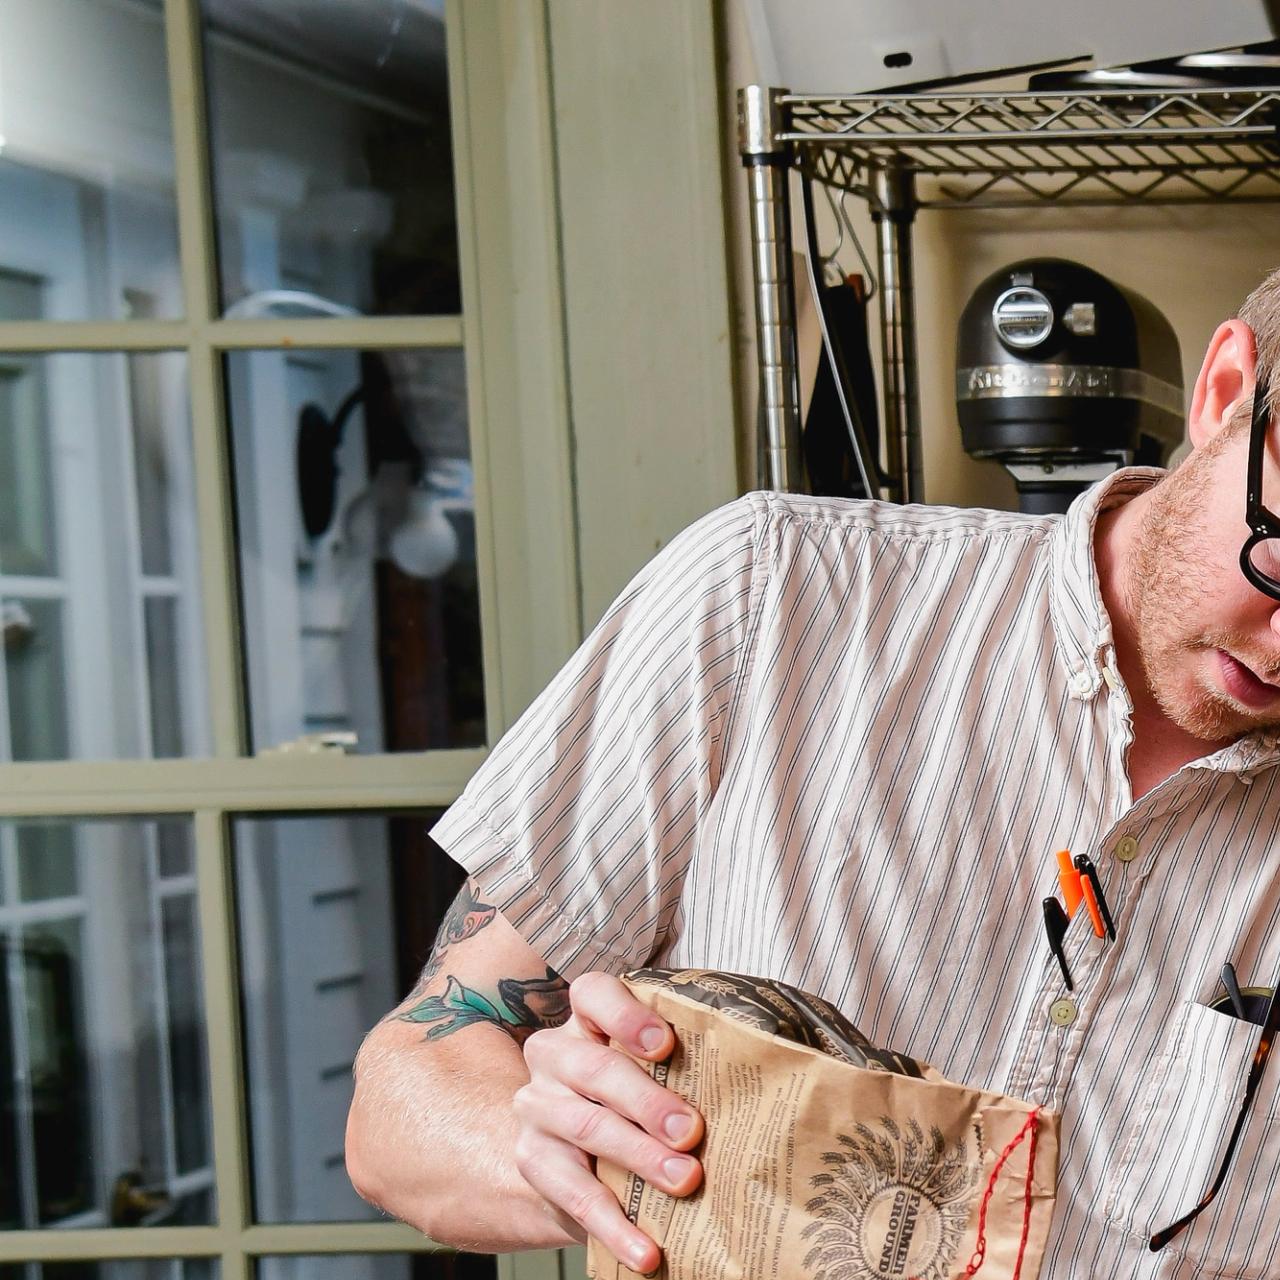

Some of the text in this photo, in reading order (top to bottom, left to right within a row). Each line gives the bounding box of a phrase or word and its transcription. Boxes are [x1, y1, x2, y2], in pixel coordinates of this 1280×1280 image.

[785, 1135, 794, 1174] GROUND
[777, 1207, 789, 1233] FROM
[877, 1190, 907, 1274] GROUND
[892, 1194, 921, 1275] FARMER
[770, 1235, 782, 1277] ORGANIC
